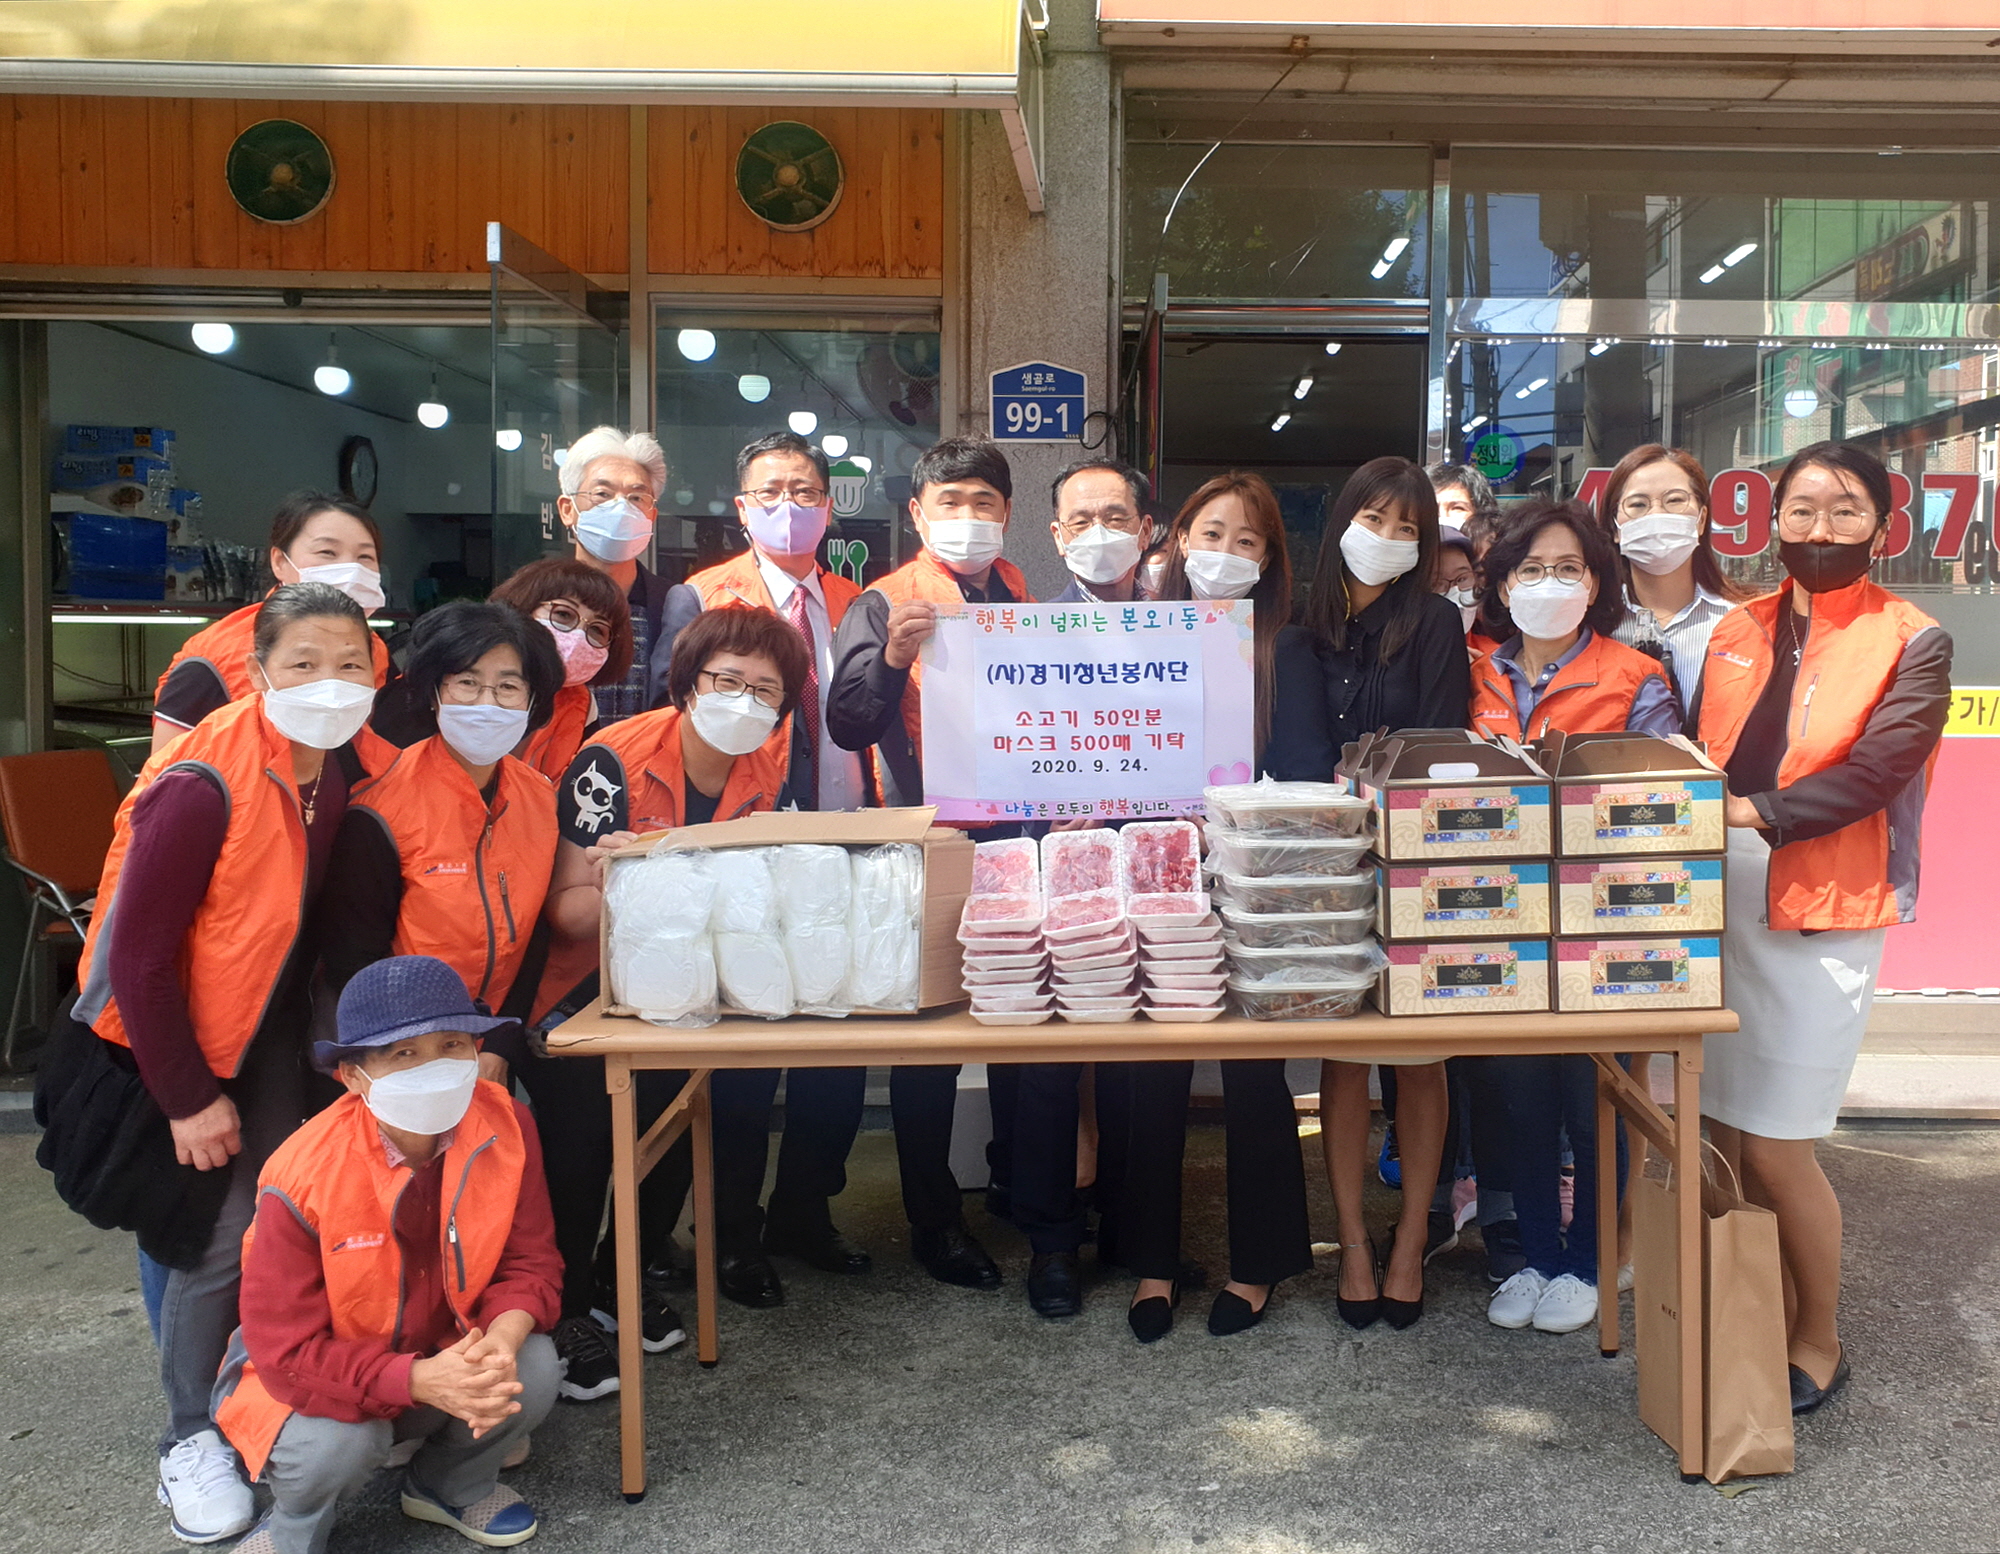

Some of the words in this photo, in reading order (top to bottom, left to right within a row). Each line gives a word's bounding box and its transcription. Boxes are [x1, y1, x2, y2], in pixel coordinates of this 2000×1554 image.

[1021, 372, 1056, 385] 샘골로
[1006, 402, 1068, 433] 99-1
[1477, 444, 1512, 466] 정회원
[975, 607, 1040, 634] 행복이
[1050, 611, 1109, 634] 넘치는
[987, 661, 1189, 686] (사)경기청년봉사단
[1015, 710, 1079, 728] 소고기
[1093, 708, 1163, 727] 50인분
[993, 735, 1058, 753] 마스크
[1070, 734, 1132, 752] 500매
[1144, 732, 1186, 751] 기탁
[1031, 760, 1083, 774] 2020.
[1093, 759, 1110, 773] 9.
[1120, 759, 1149, 773] 24.
[1005, 801, 1049, 818] 나눔은
[1055, 802, 1094, 816] 모두의
[1099, 798, 1175, 816] 행복입니다.
